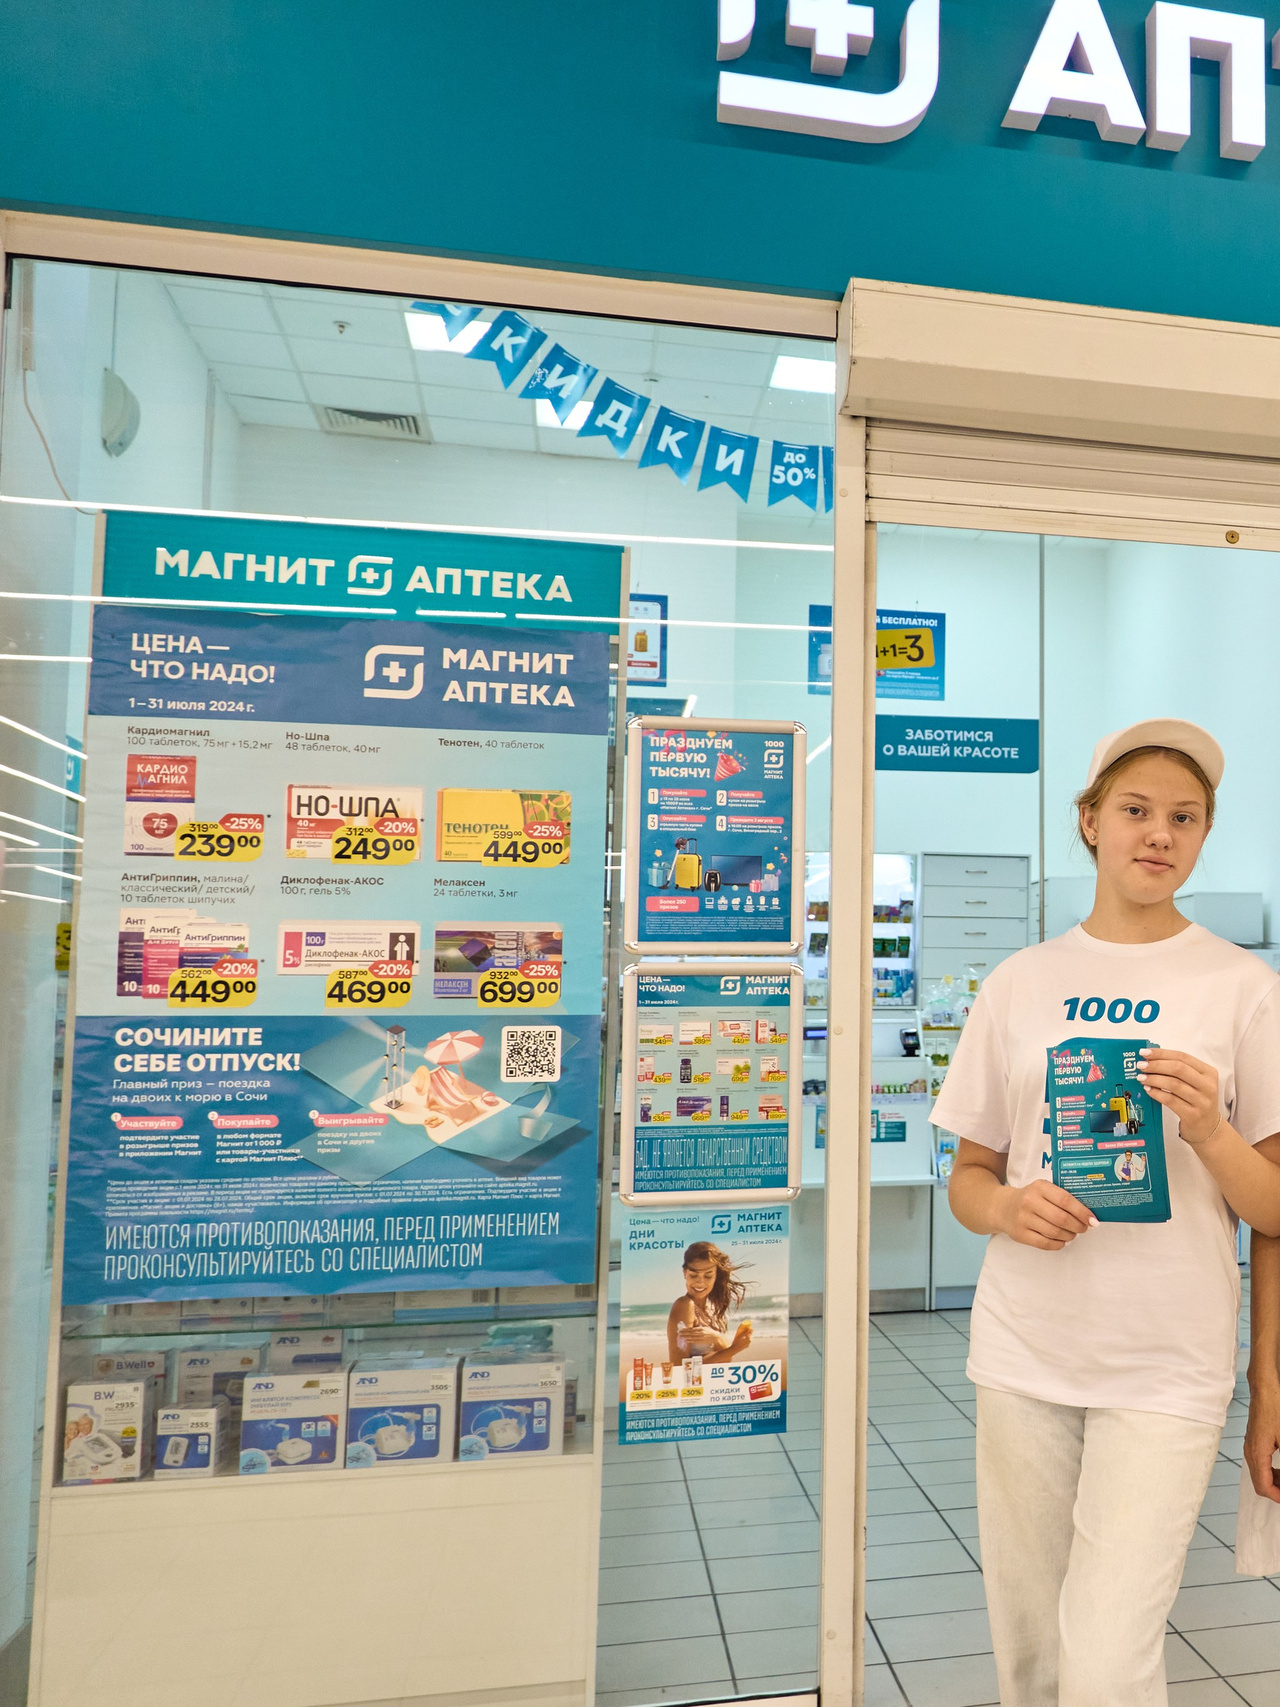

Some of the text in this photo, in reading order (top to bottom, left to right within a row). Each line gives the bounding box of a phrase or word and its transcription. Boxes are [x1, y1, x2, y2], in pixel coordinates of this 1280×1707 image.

[783, 452, 806, 464] до
[771, 466, 816, 487] 50%
[155, 547, 573, 603] МАГНИТ АПТЕКА
[882, 617, 937, 627] БЕСПЛАТНО!
[442, 648, 574, 676] МАГНИТ
[130, 661, 275, 686] ЧТО НАДО!
[443, 681, 575, 707] АПТЕКА
[167, 699, 207, 714] июля
[127, 726, 210, 738] Кардиомагнил
[286, 732, 330, 742] Но-Шпа
[905, 729, 993, 743] ЗАБОТИМСЯ
[127, 737, 200, 748] 100 таблеток,
[285, 742, 351, 753] 48 таблеток,
[438, 738, 544, 750] Тенотен, 40 таблеток
[650, 736, 733, 750] ПРАЗДНУЕМ
[764, 740, 784, 748] 1000
[883, 741, 1020, 759] О ВАШЕЙ КРАСОТЕ
[650, 752, 707, 764] ПЕРВУЮ
[136, 763, 188, 774] КАРДИО
[650, 766, 711, 779] ТЫСЯЧУ!
[296, 795, 399, 817] НО-ШПА
[225, 816, 262, 831] -25%
[379, 820, 415, 834] -20%
[528, 825, 562, 837] -25%
[121, 873, 200, 884] АнтиГриппин,
[281, 875, 384, 886] Диклофенак-АКОС
[434, 878, 485, 887] Мелаксен
[120, 894, 235, 904] 10 таблеток шипучих
[217, 963, 255, 976] -20%
[373, 964, 410, 976] -20%
[524, 964, 558, 977] -25%
[746, 976, 790, 984] МАГНИТ
[746, 987, 790, 995] АПТЕКА
[1063, 996, 1160, 1024] 1000
[114, 1027, 263, 1047] СОЧИНИТЕ
[114, 1053, 300, 1072] СЕБЕ ОТПУСК!
[1053, 1055, 1094, 1065] ПРАЗДНУЕМ
[1054, 1066, 1082, 1075] ПЕРВУЮ
[113, 1079, 271, 1090] Главный приз поездка
[112, 1094, 128, 1103] на
[131, 1094, 171, 1104] двоих
[185, 1093, 221, 1103] морю
[235, 1092, 268, 1101] Сочи
[121, 1118, 177, 1129] Участвуйте
[217, 1118, 271, 1127] Покупайте
[318, 1117, 385, 1126] Выигрывайте
[629, 1218, 651, 1226] Цена
[677, 1216, 699, 1224] надо!
[738, 1212, 782, 1221] МАГНИТ
[106, 1212, 559, 1250] ИМЕЮТСЯ ПРОТИВОПОКАЗАНИЯ, ПЕРЕД ПРИМЕНЕНИЕМ
[738, 1224, 782, 1233] АПТЕКА
[629, 1230, 655, 1240] ДНИ
[629, 1240, 684, 1250] КРАСОТЫ
[104, 1243, 483, 1280] ПРОКОНСУЛЬТИРУЙТЕСЬ СО СПЕЦИАЛИСТОМ
[711, 1364, 779, 1385] до 30%
[710, 1387, 740, 1395] скидки
[722, 1394, 745, 1403] карте
